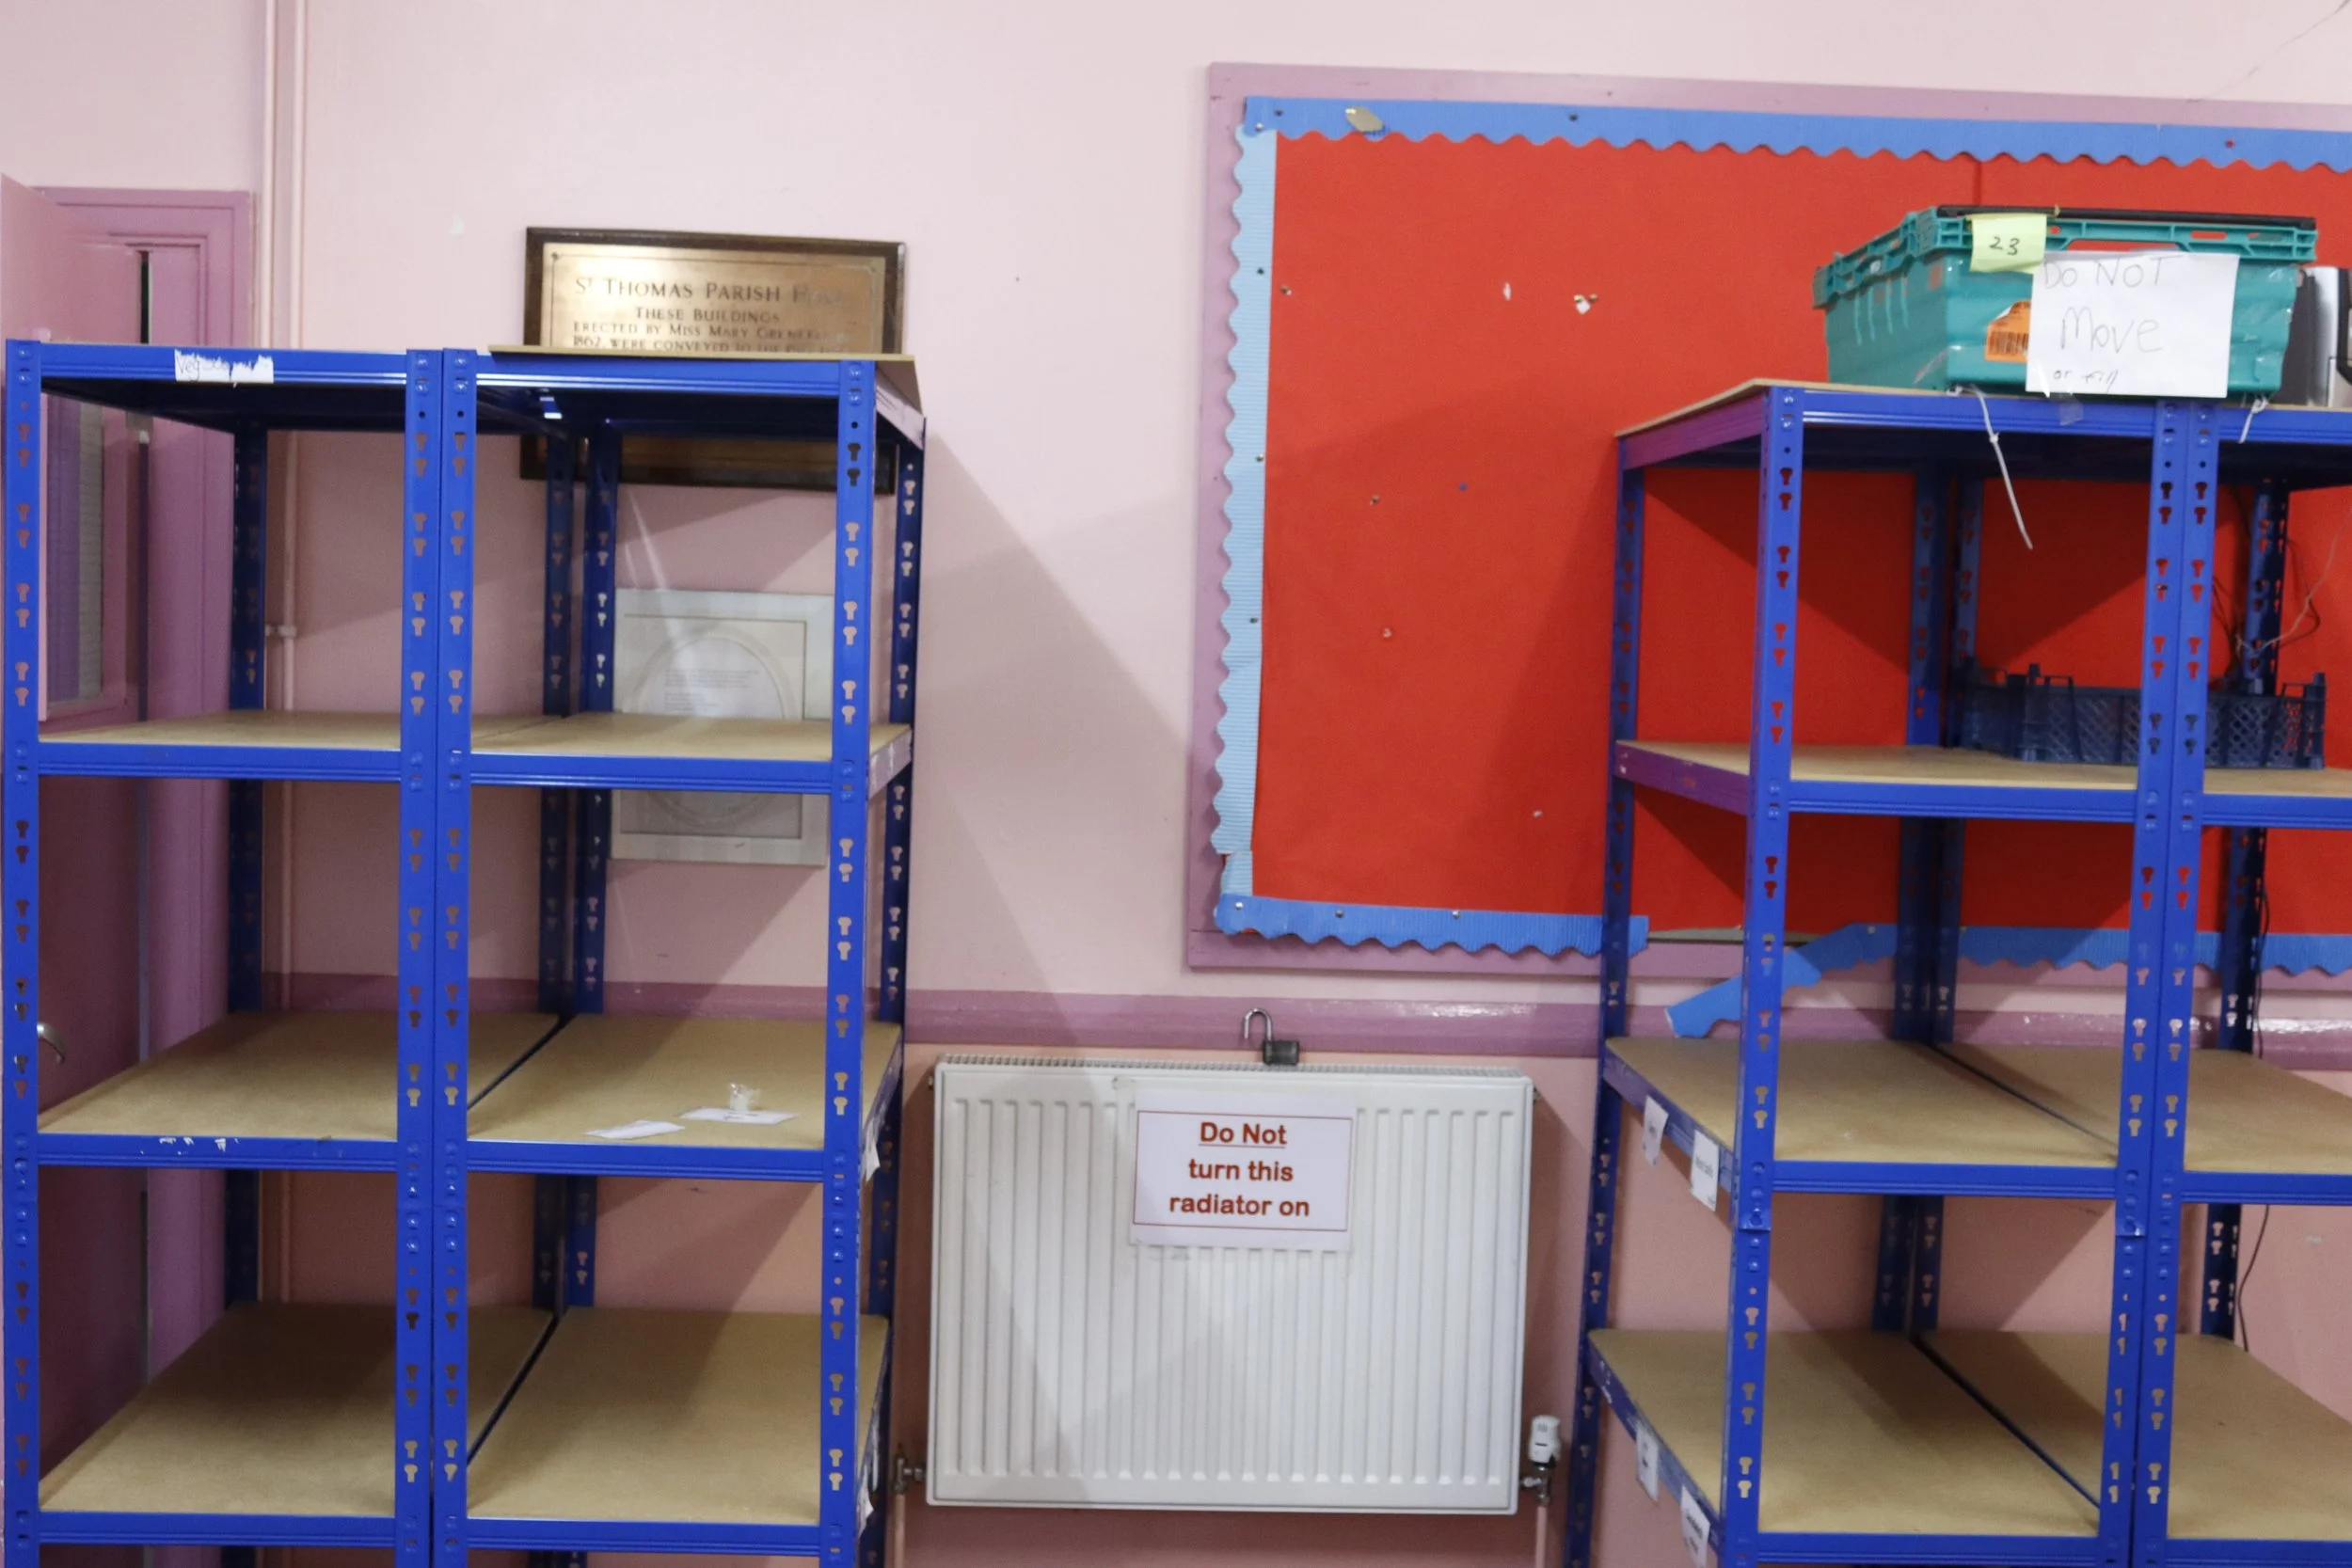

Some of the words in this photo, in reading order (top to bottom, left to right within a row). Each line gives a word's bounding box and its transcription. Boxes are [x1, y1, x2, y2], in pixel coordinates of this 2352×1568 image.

[1989, 235, 2020, 256] 23
[2094, 255, 2184, 288] NOT
[602, 277, 693, 298] THOMAS
[706, 280, 780, 302] PARISH
[636, 306, 684, 321] THESE
[693, 308, 780, 324] BUILDINGS
[573, 321, 638, 334] ERECTED
[645, 323, 661, 335] BY
[669, 323, 701, 337] MISS
[709, 325, 748, 338] MARY
[1200, 1121, 1234, 1143] Do
[1243, 1123, 1287, 1145] Not
[1188, 1158, 1240, 1180] turn
[1248, 1161, 1294, 1181] this
[1169, 1194, 1273, 1215] radiator
[1279, 1200, 1310, 1217] on
